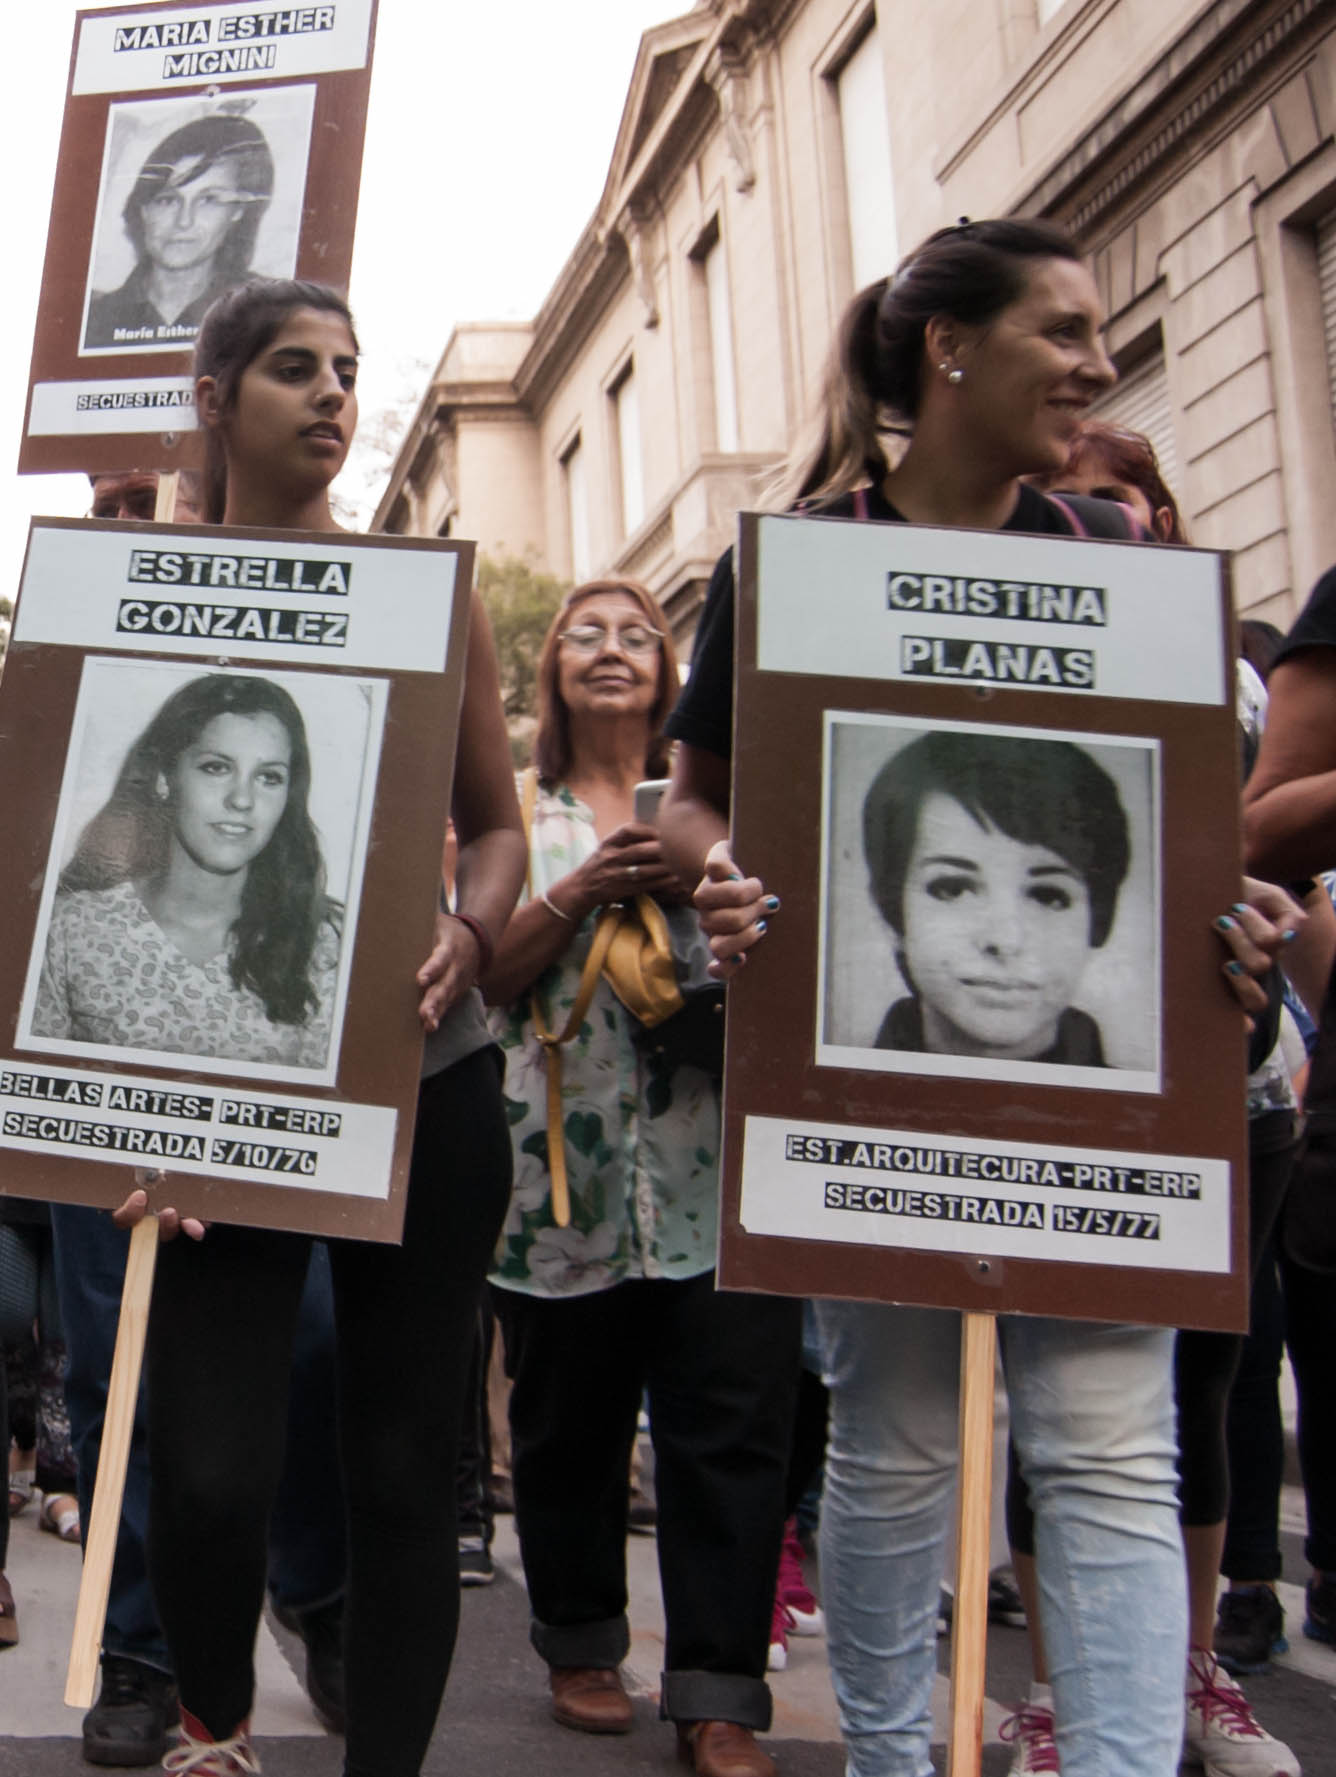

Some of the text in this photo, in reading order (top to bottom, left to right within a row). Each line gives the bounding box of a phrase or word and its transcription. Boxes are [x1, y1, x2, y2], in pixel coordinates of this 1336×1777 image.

[115, 7, 335, 51] MARIA ESTHER
[163, 46, 275, 78] MIGNINI
[129, 551, 349, 594] ESTRELLA
[889, 574, 1106, 625] CRISTINA
[118, 601, 348, 646] GONZALEZ
[902, 638, 1093, 686] PLANAS
[220, 1101, 341, 1137] PRT-ERP
[3, 1113, 316, 1175] SECUESTRADA 5/10/76
[825, 1183, 1160, 1238] SECUESTRADA 15/5/77
